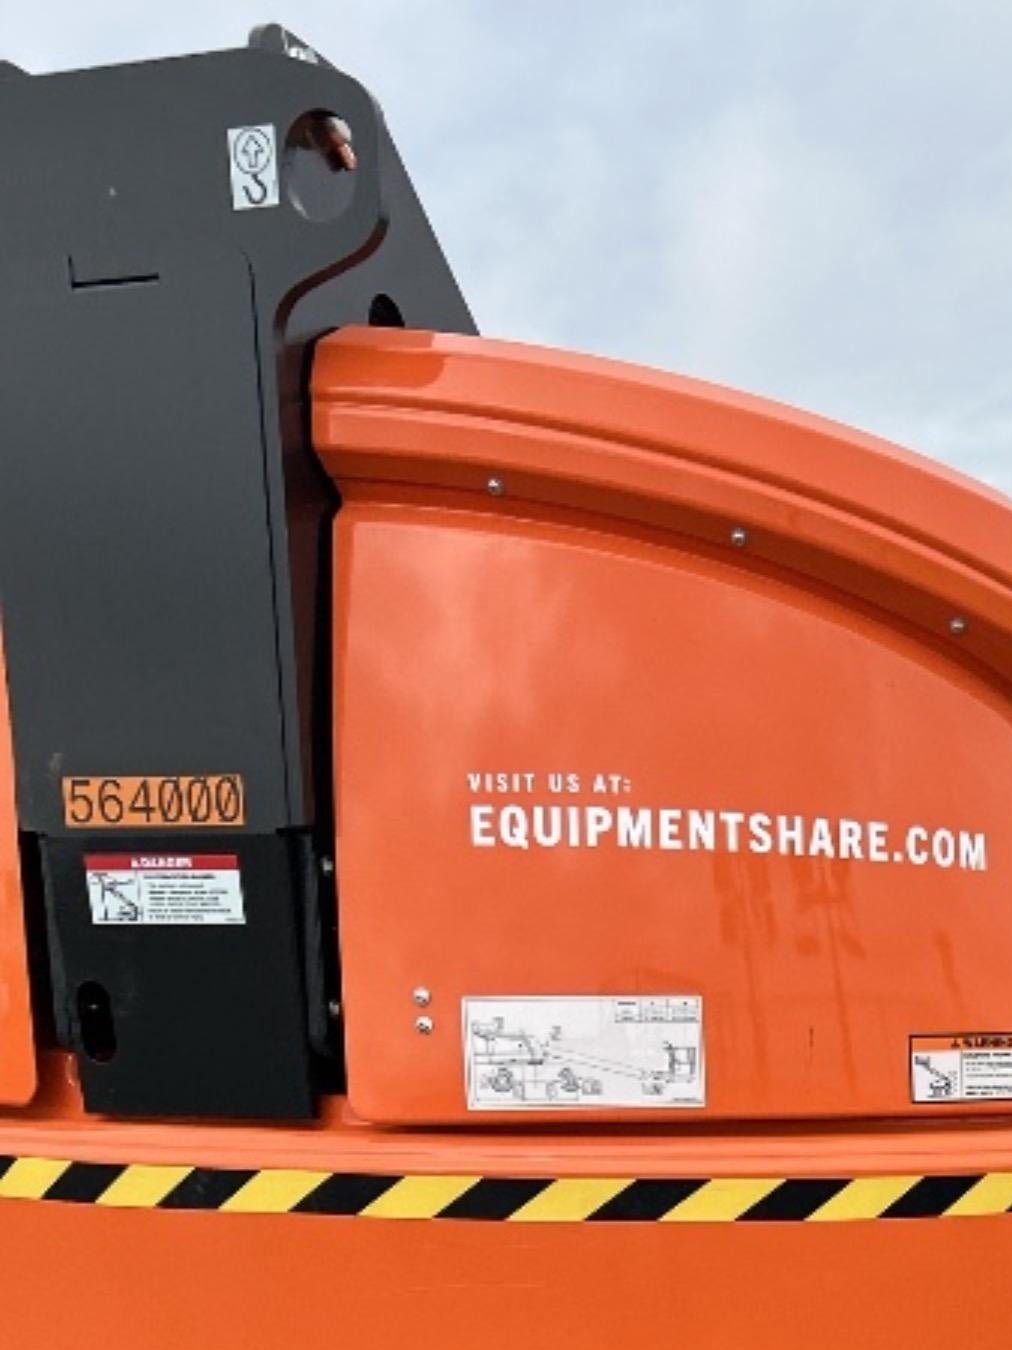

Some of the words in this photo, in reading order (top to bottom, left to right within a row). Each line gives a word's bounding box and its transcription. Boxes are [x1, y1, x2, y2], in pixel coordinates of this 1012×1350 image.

[69, 775, 242, 824] 564000
[467, 773, 535, 793] VISIT
[549, 773, 581, 793] US
[593, 774, 632, 794] AT:
[470, 803, 989, 871] EQUIPMENTSHARE.COM
